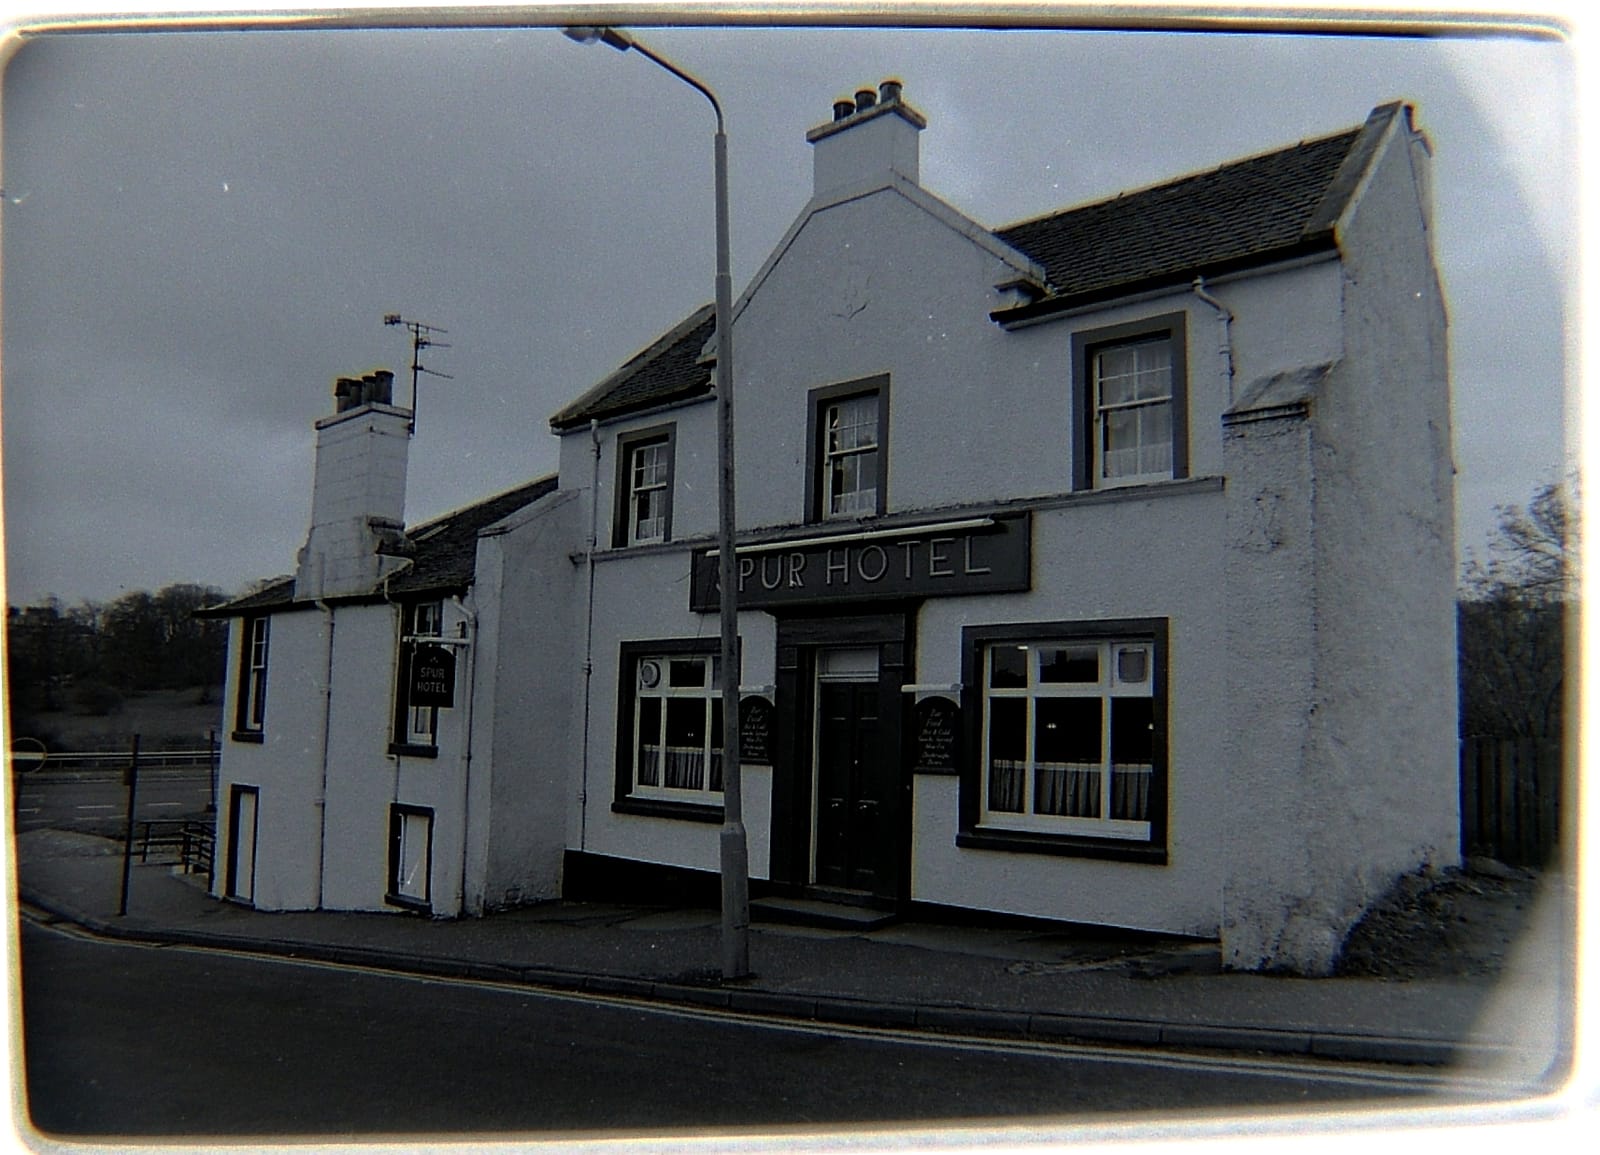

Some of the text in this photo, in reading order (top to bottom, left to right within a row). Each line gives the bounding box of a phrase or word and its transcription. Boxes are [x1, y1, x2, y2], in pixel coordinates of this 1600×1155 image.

[716, 536, 992, 592] PUR HOTEL
[420, 666, 445, 680] SPUR
[417, 681, 447, 694] HOTEL
